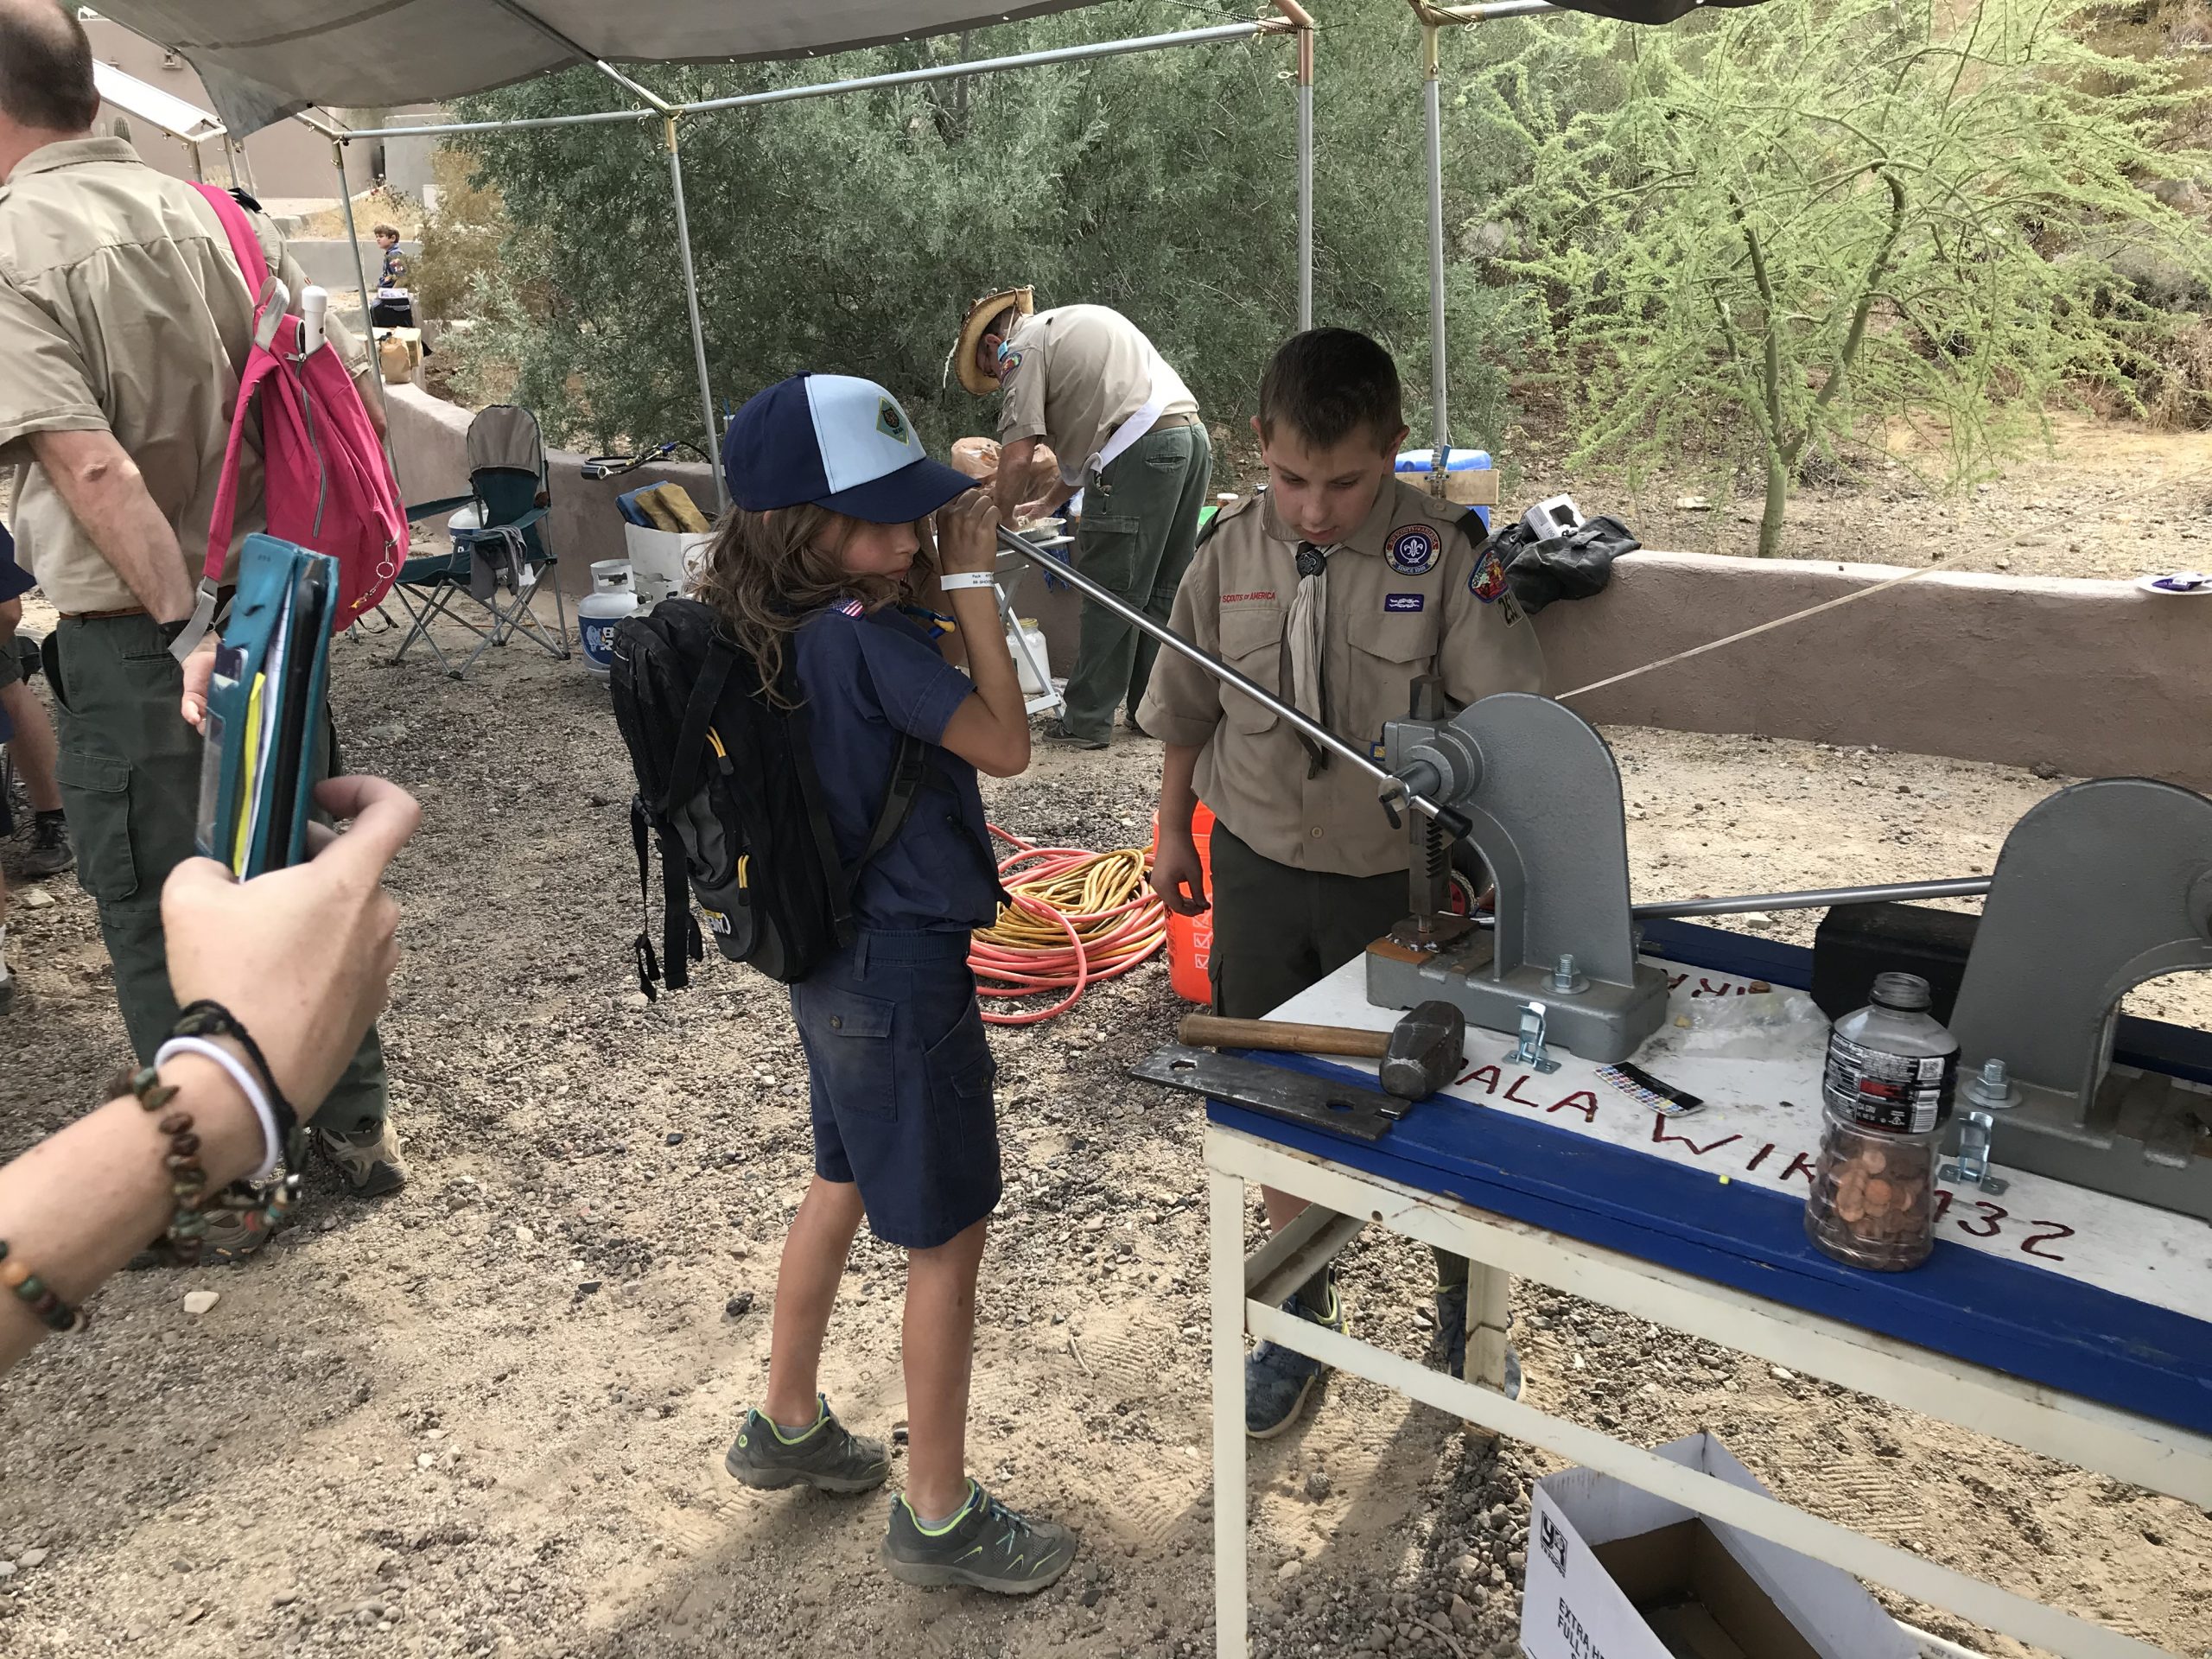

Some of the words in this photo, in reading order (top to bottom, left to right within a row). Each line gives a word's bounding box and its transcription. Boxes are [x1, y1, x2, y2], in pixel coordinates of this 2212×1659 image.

[1223, 594, 1243, 603] SCOUTS
[1249, 591, 1275, 601] AMERICA
[1454, 1058, 1598, 1122] ALA
[1558, 1614, 1580, 1657] FULL
[1559, 1596, 1590, 1650] EXTRA
